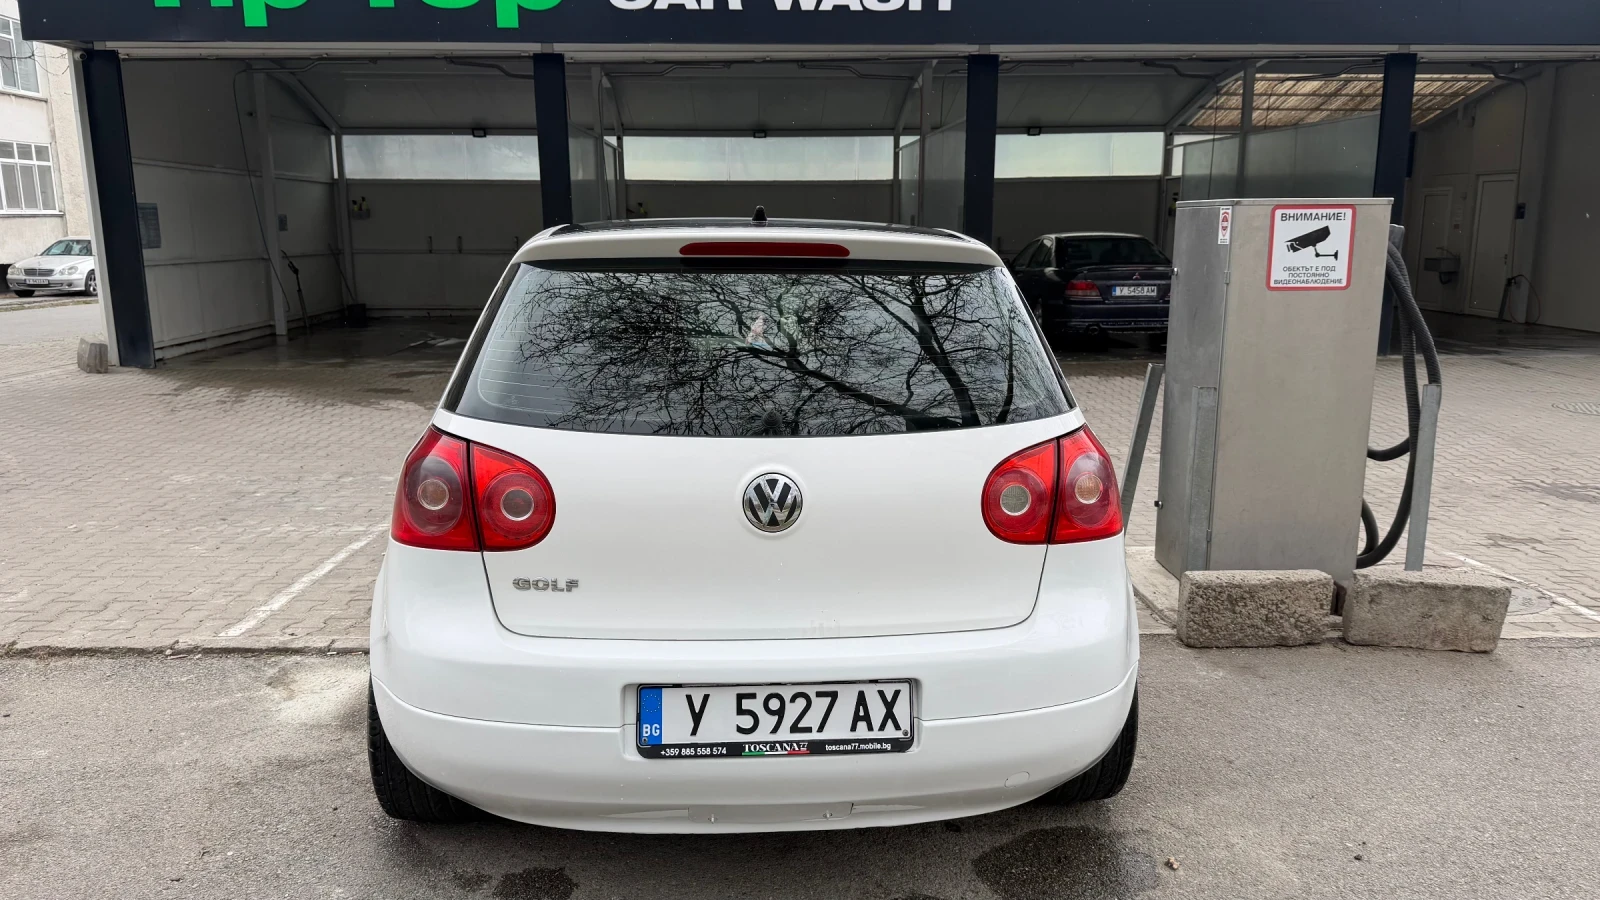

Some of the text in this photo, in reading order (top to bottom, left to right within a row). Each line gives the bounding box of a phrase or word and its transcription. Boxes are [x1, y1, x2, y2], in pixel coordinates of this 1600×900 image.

[1280, 212, 1346, 222] ВНИМАНИЕ!
[744, 474, 802, 531] VW
[512, 577, 579, 592] GOLF
[735, 690, 839, 735] 5927
[850, 689, 902, 733] AX
[642, 723, 660, 737] BG
[660, 748, 679, 756] +359
[697, 747, 711, 755] 558
[712, 747, 727, 755] 574
[825, 742, 892, 751] toscana77.mobile.bg
